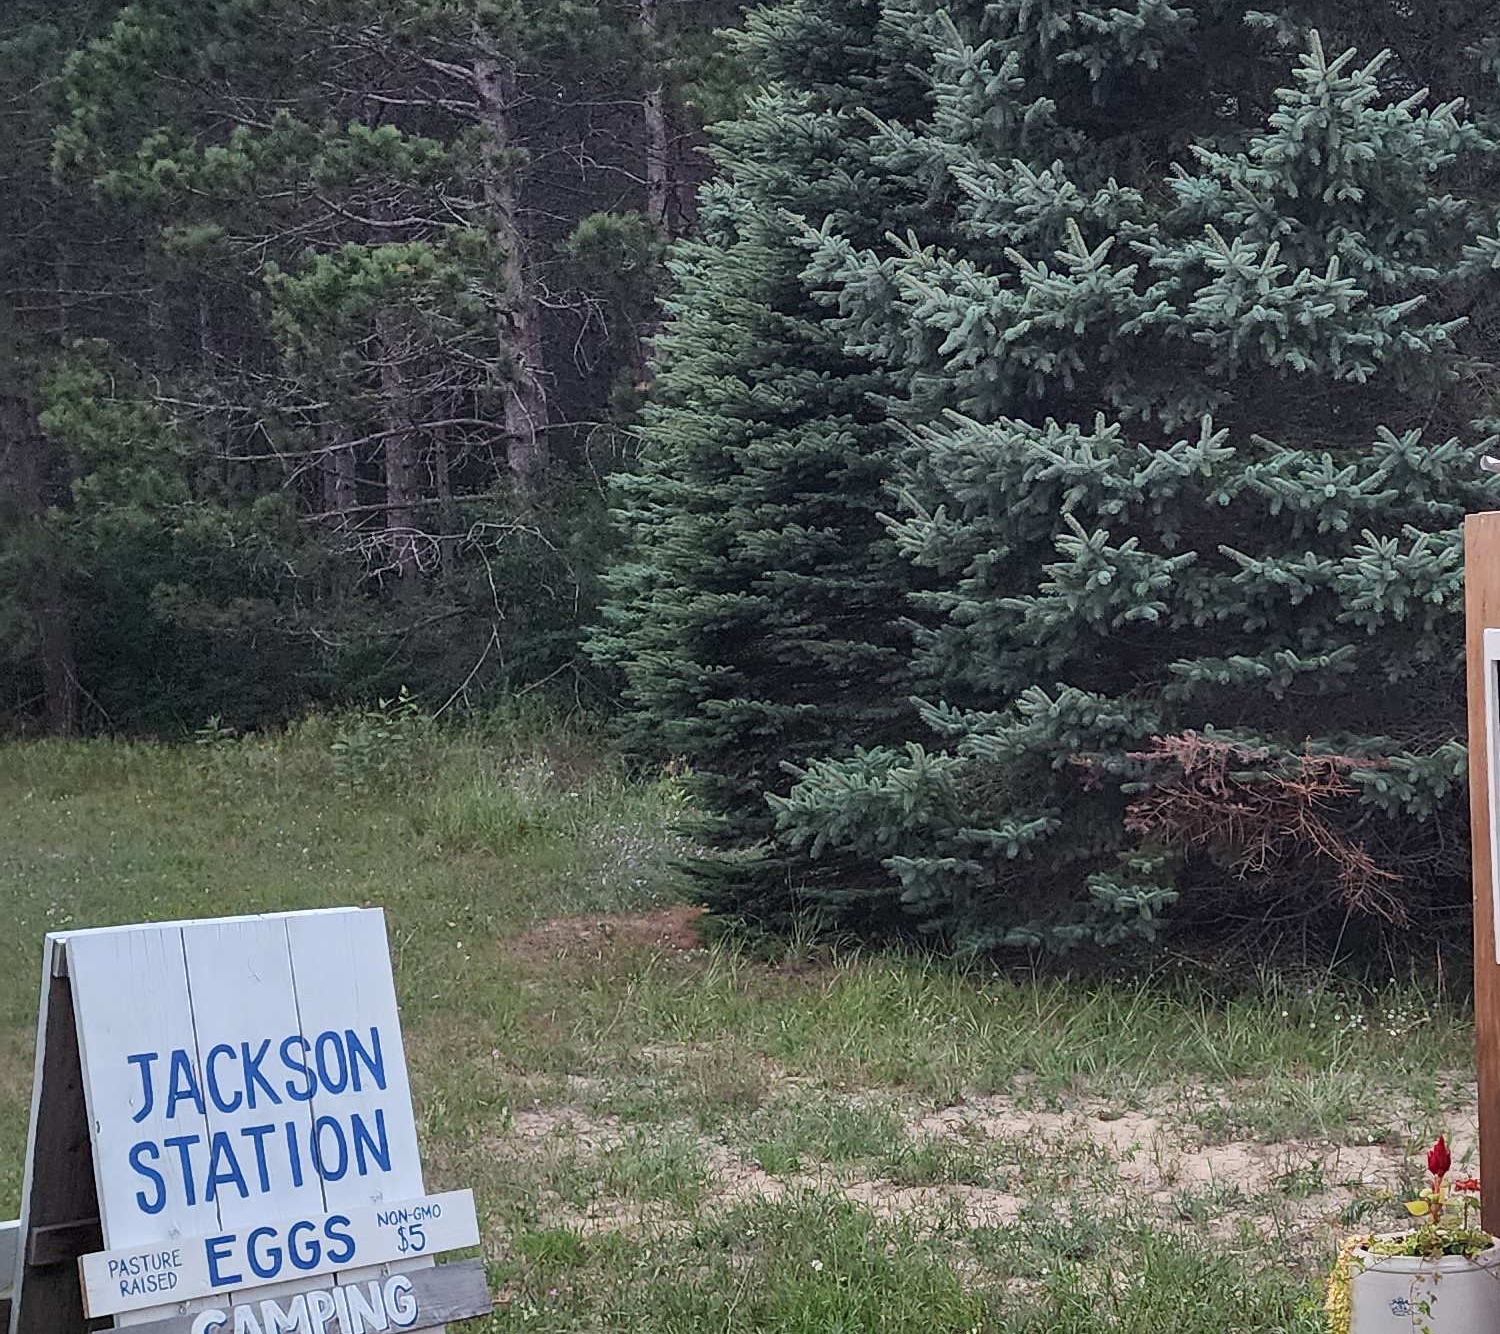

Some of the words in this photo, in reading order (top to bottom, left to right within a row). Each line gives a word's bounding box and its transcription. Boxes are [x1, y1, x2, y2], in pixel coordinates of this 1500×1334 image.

[126, 1026, 388, 1124] JACKSON
[128, 1108, 392, 1215] STATION
[376, 1203, 442, 1229] NON-GMO
[204, 1214, 356, 1288] EGGS
[396, 1222, 427, 1255] $5
[107, 1248, 184, 1279] PASTURE
[119, 1270, 179, 1298] RAISED
